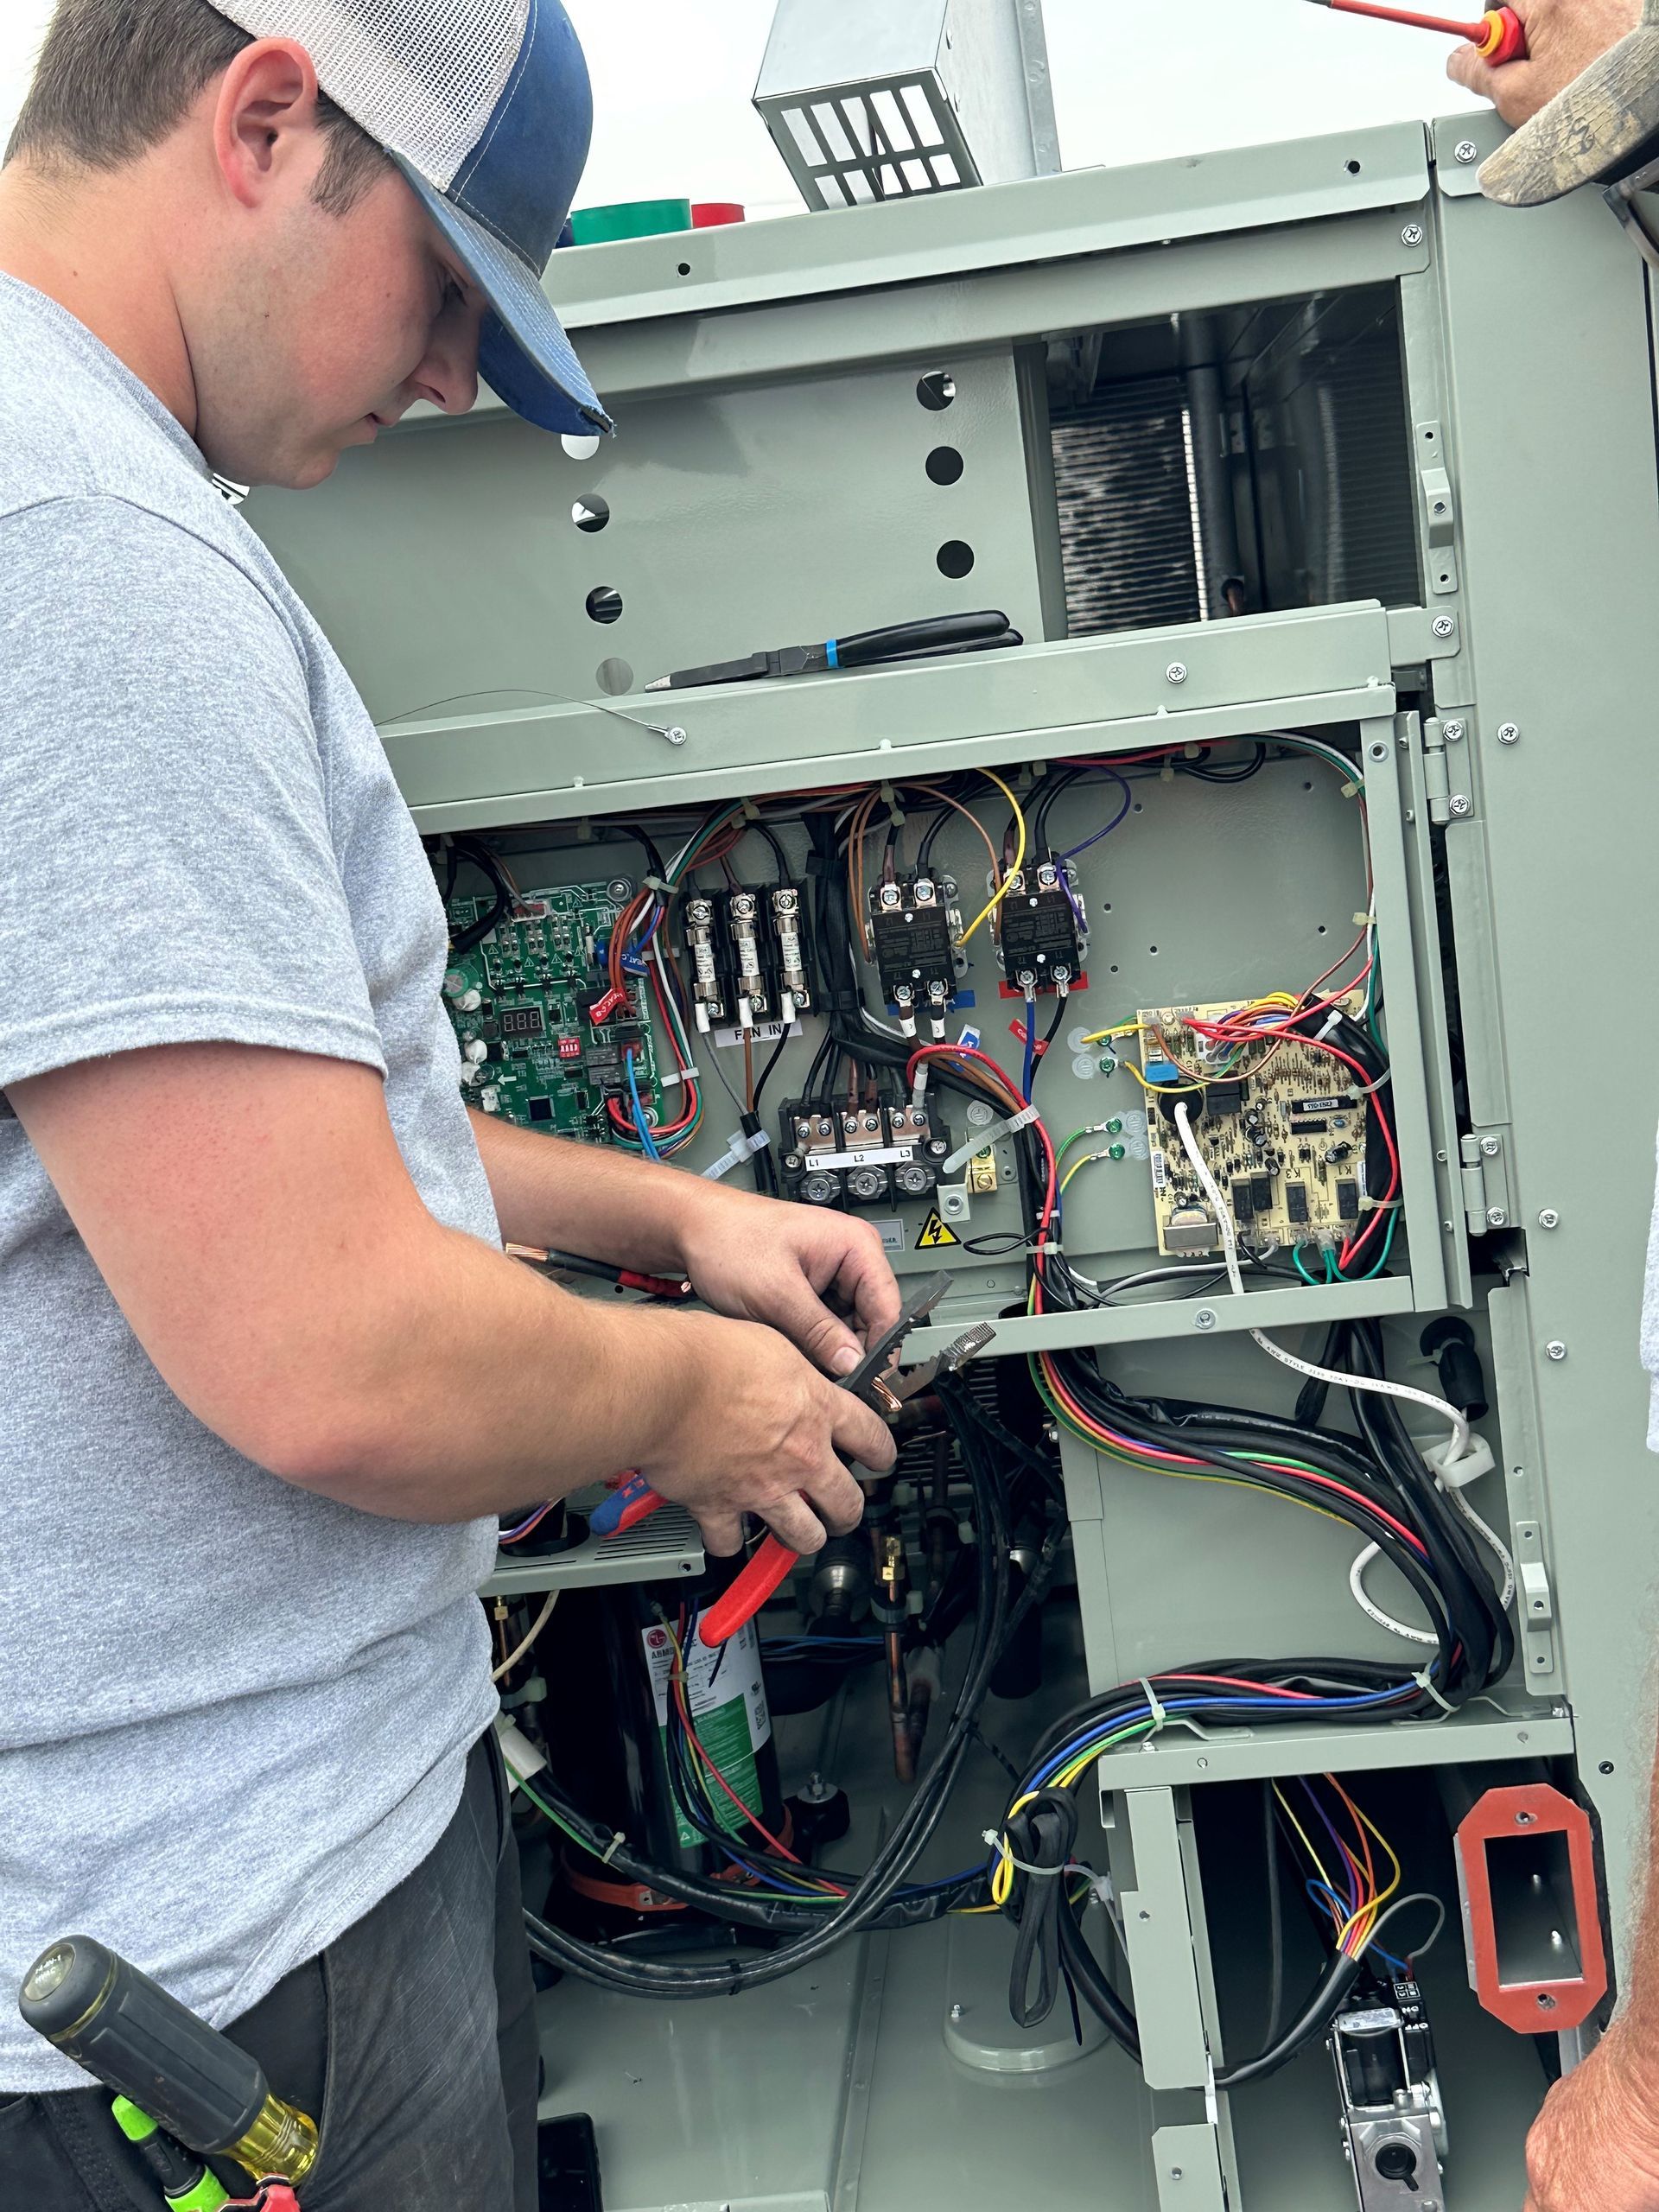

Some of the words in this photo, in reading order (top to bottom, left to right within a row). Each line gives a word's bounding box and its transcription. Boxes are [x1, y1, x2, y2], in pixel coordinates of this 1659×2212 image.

[768, 1023, 782, 1035] IN
[809, 1159, 819, 1167] L1
[1404, 2022, 1429, 2031] OFF
